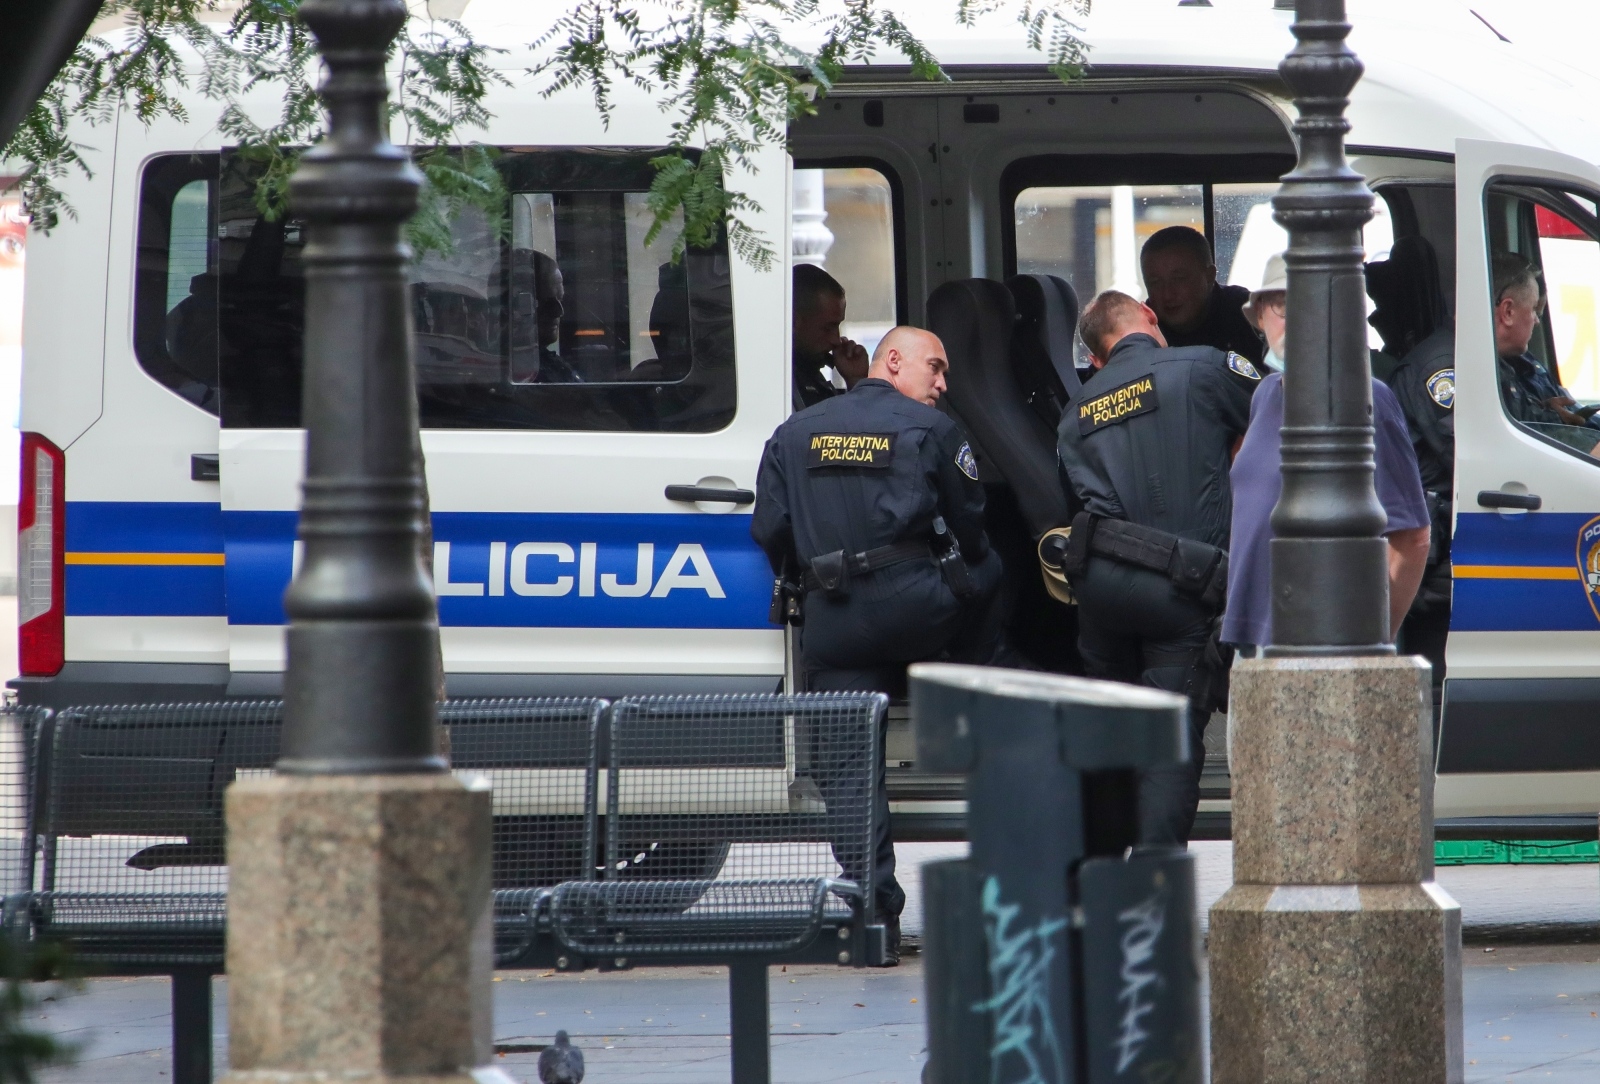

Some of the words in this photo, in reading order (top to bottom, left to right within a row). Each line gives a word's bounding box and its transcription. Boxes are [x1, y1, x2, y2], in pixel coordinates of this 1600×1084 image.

[1080, 379, 1153, 419] INTERVENTNA
[1093, 397, 1142, 425] POLICIJA
[811, 435, 889, 451] INTERVENTNA
[821, 448, 873, 462] POLICIJA
[292, 540, 727, 598] LICIJA
